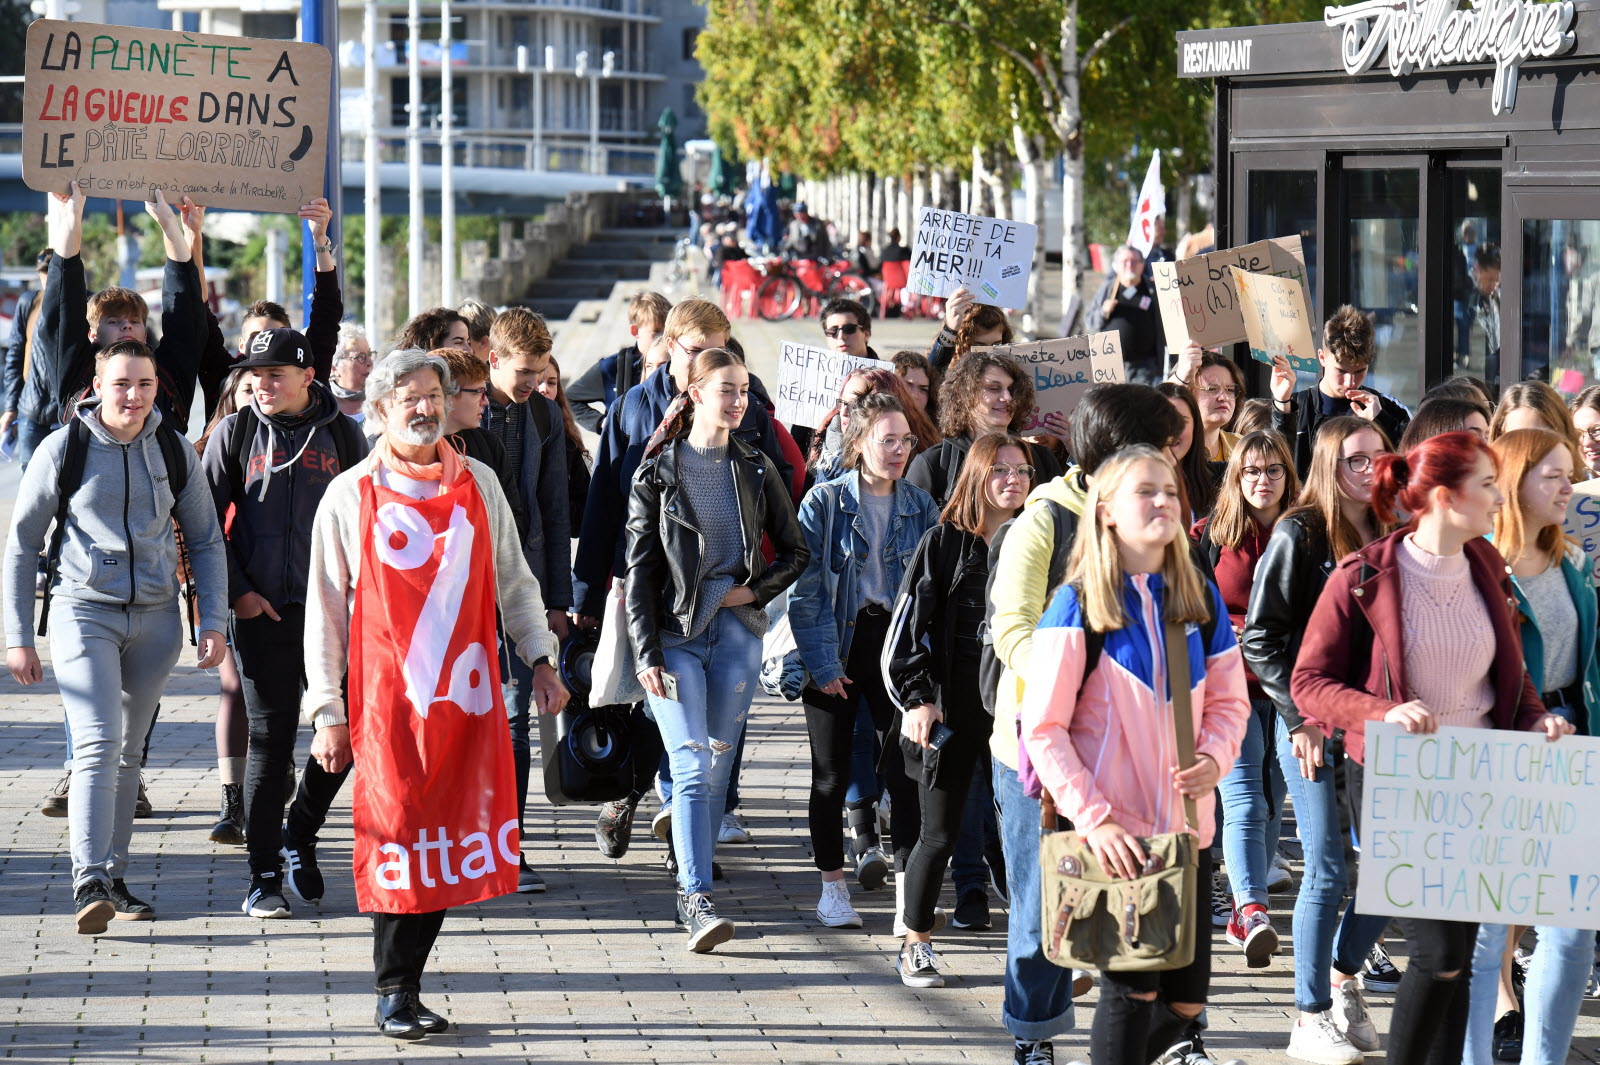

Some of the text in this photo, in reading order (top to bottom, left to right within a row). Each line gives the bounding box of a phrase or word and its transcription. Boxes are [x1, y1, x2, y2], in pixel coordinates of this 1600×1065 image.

[41, 31, 300, 87] LA PLANÈTE A
[1183, 39, 1252, 73] RESTAURANT
[39, 84, 297, 128] LA GUEULE DANS
[41, 133, 75, 169] LE
[84, 121, 149, 164] PÂTÉ
[98, 178, 113, 190] ce
[149, 182, 168, 197] pas
[171, 177, 180, 192] à
[183, 184, 208, 195] cause
[212, 181, 224, 194] de
[230, 180, 237, 195] la
[920, 212, 1016, 243] ARRÊTE DE
[984, 242, 1001, 259] TA
[1160, 268, 1194, 291] You
[1067, 348, 1097, 362] vous
[1102, 335, 1116, 355] la
[779, 381, 836, 409] RÉCHAU
[1035, 366, 1117, 391] bleue ou
[1374, 735, 1411, 778] LE
[1514, 743, 1597, 786] CHANGE
[1372, 787, 1407, 820] ET
[1502, 795, 1577, 835] QUAND
[375, 818, 520, 889] attac
[1373, 831, 1552, 868] EST CE QUE ON
[1385, 864, 1556, 916] CHANGE
